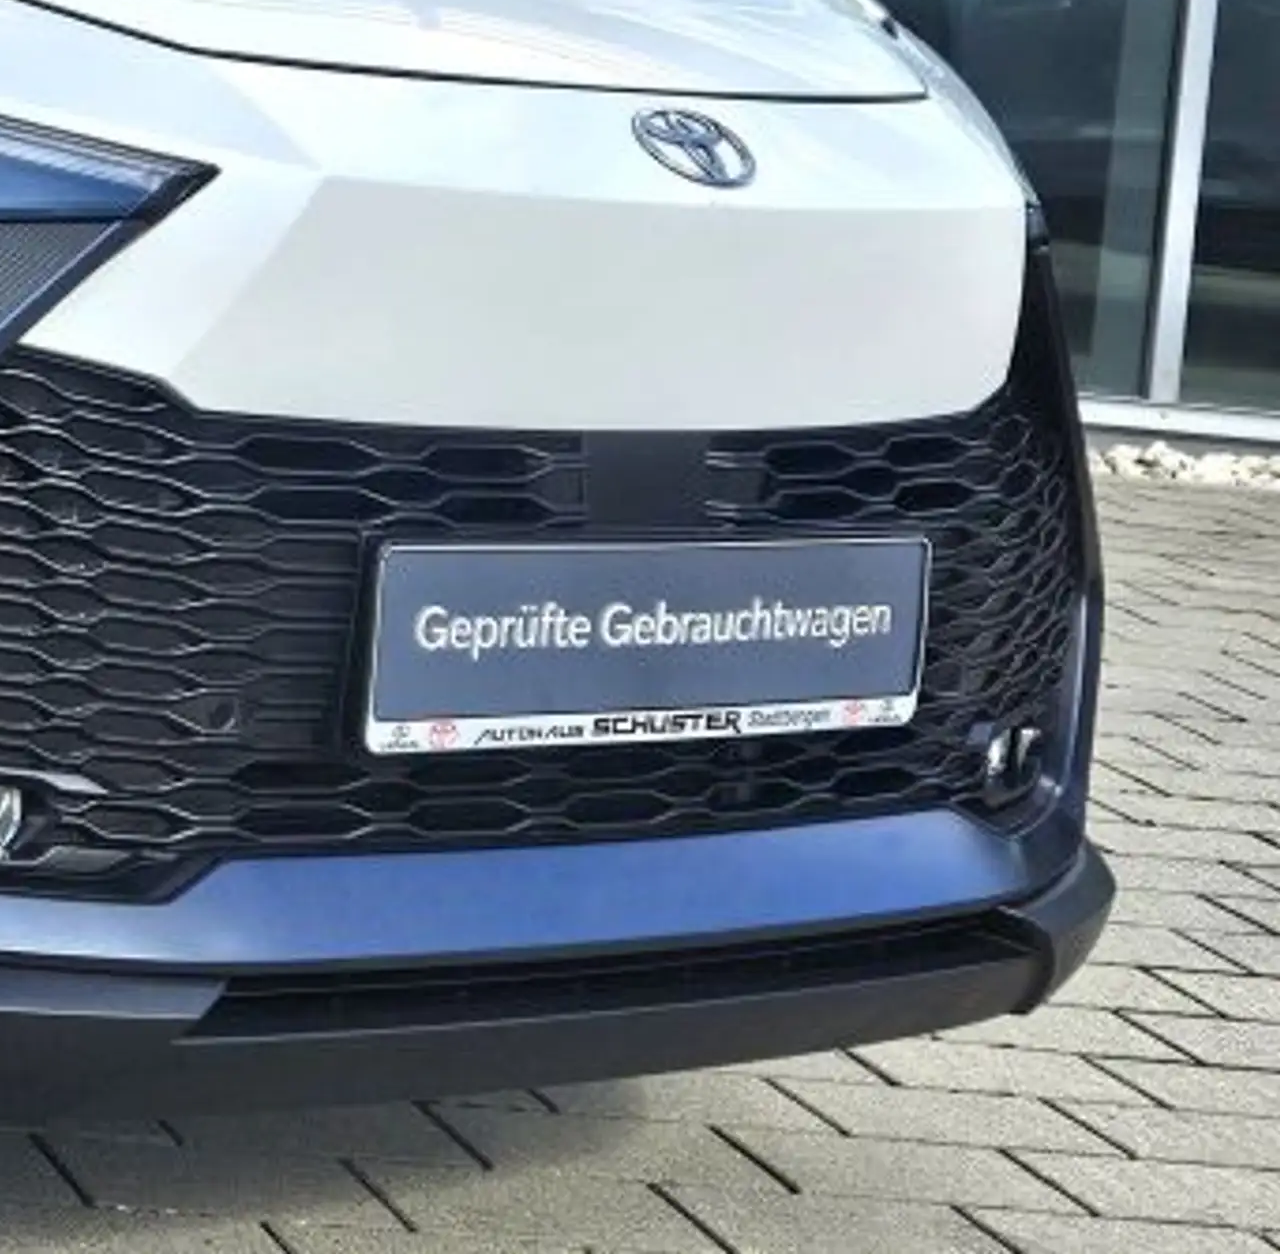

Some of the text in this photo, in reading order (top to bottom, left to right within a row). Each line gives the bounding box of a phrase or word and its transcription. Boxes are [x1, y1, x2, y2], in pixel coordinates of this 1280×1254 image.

[414, 596, 893, 662] Geprüfte Gebrauchtwagen
[592, 711, 743, 736] SCHUSTER
